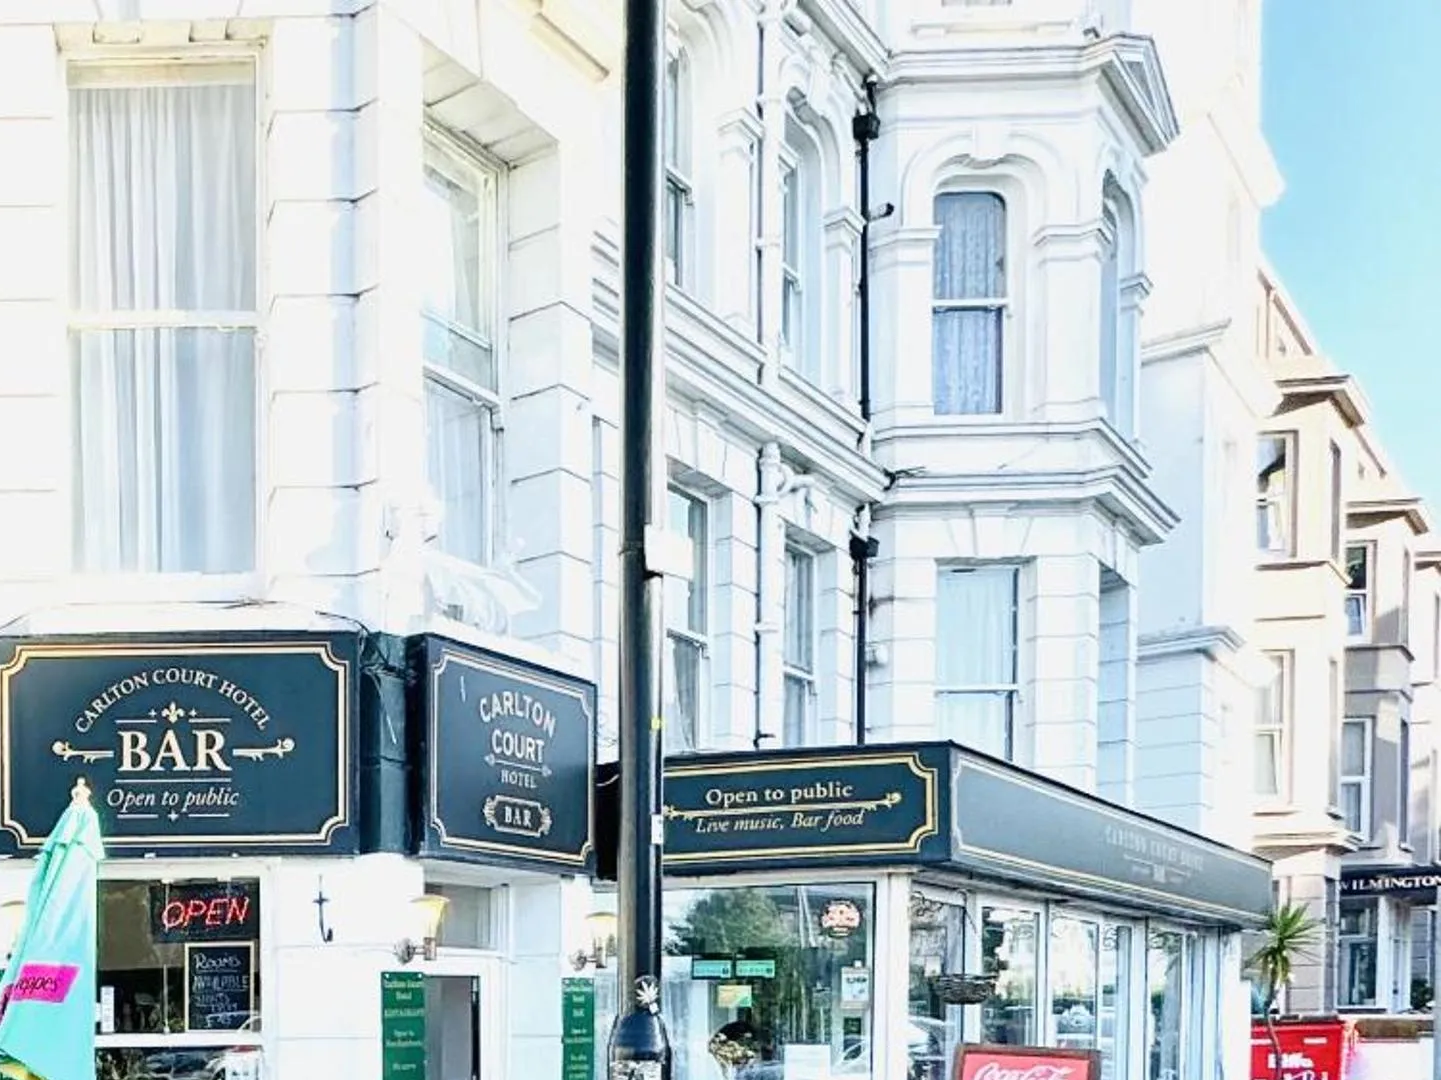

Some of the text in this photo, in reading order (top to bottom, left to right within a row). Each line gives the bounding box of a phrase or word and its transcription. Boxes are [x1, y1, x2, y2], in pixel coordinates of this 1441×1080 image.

[75, 668, 271, 733] CARLTON COURT HOTEL
[479, 691, 556, 738] CARLTON
[117, 729, 233, 772] BAR
[491, 729, 545, 763] COURT
[500, 770, 538, 789] HOTEL
[107, 786, 240, 812] Open to public
[705, 782, 854, 809] Open to public
[504, 806, 534, 828] BAR
[695, 808, 865, 834] Live music, Bar food
[162, 896, 250, 928] OPEN
